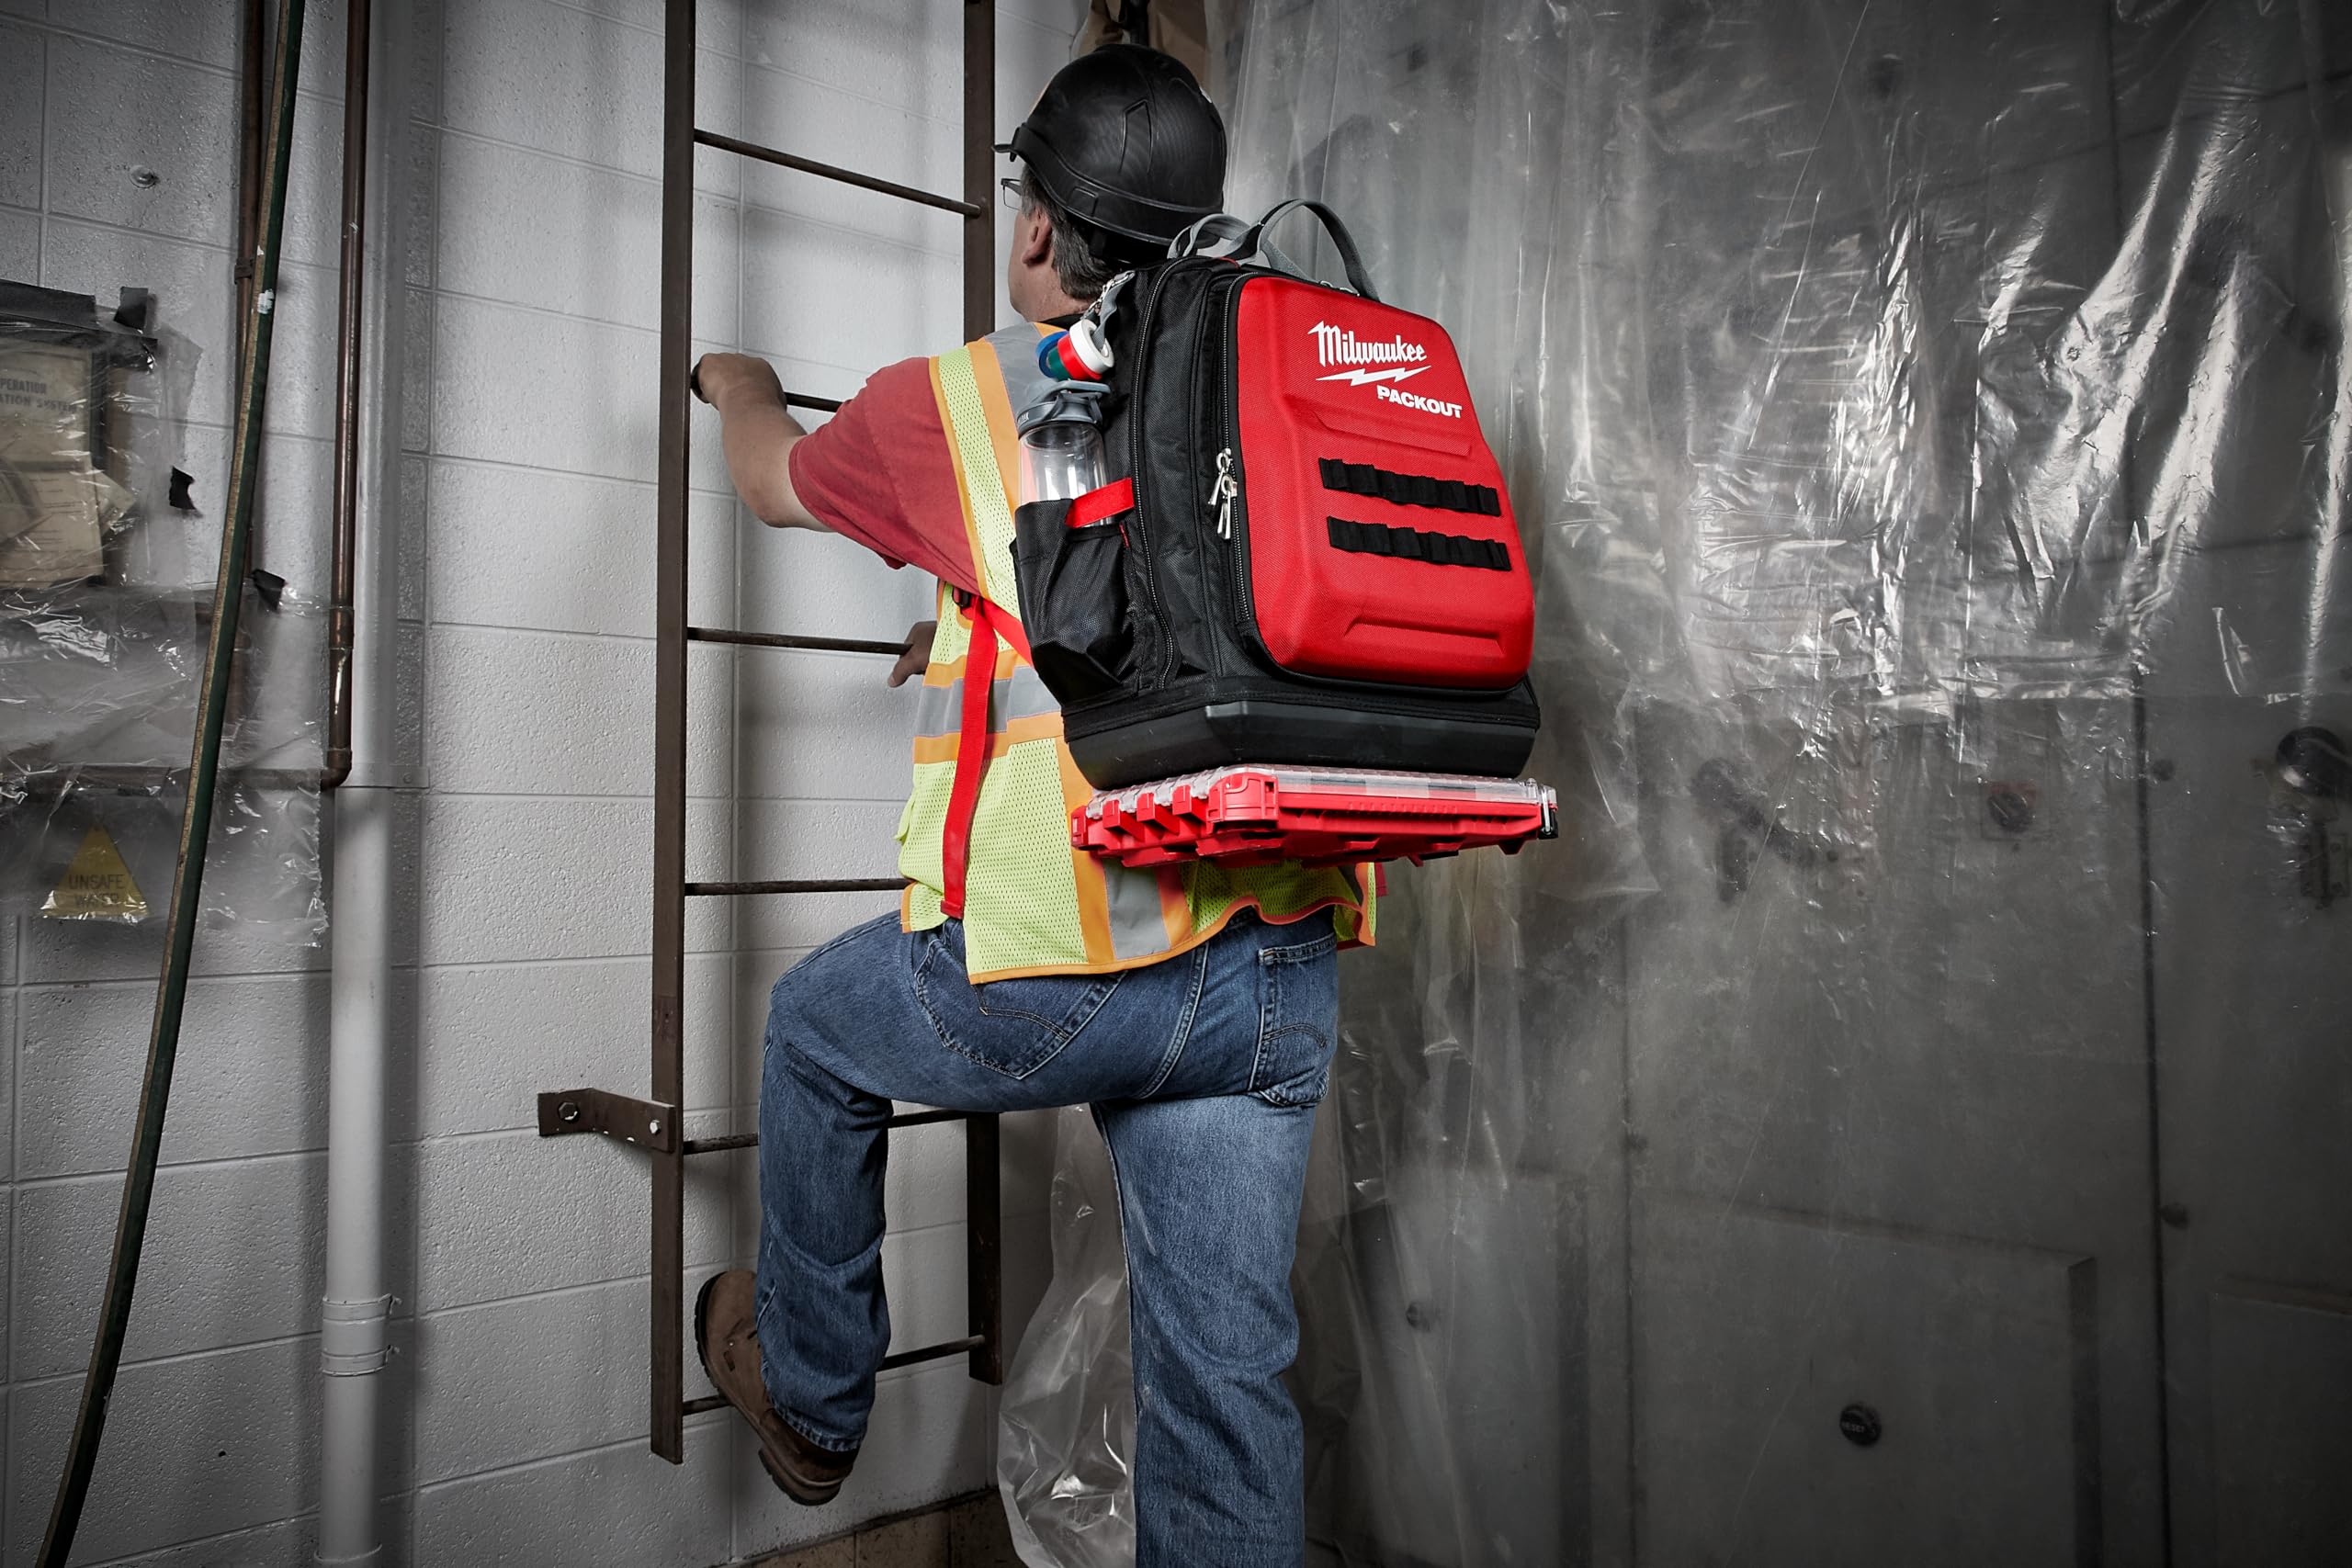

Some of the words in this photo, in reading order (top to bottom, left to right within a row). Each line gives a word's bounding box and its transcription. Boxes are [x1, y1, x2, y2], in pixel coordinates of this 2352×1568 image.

[1307, 320, 1428, 367] Milwaukee
[1376, 385, 1463, 419] PACKOUT
[69, 874, 125, 890] UNSAFE
